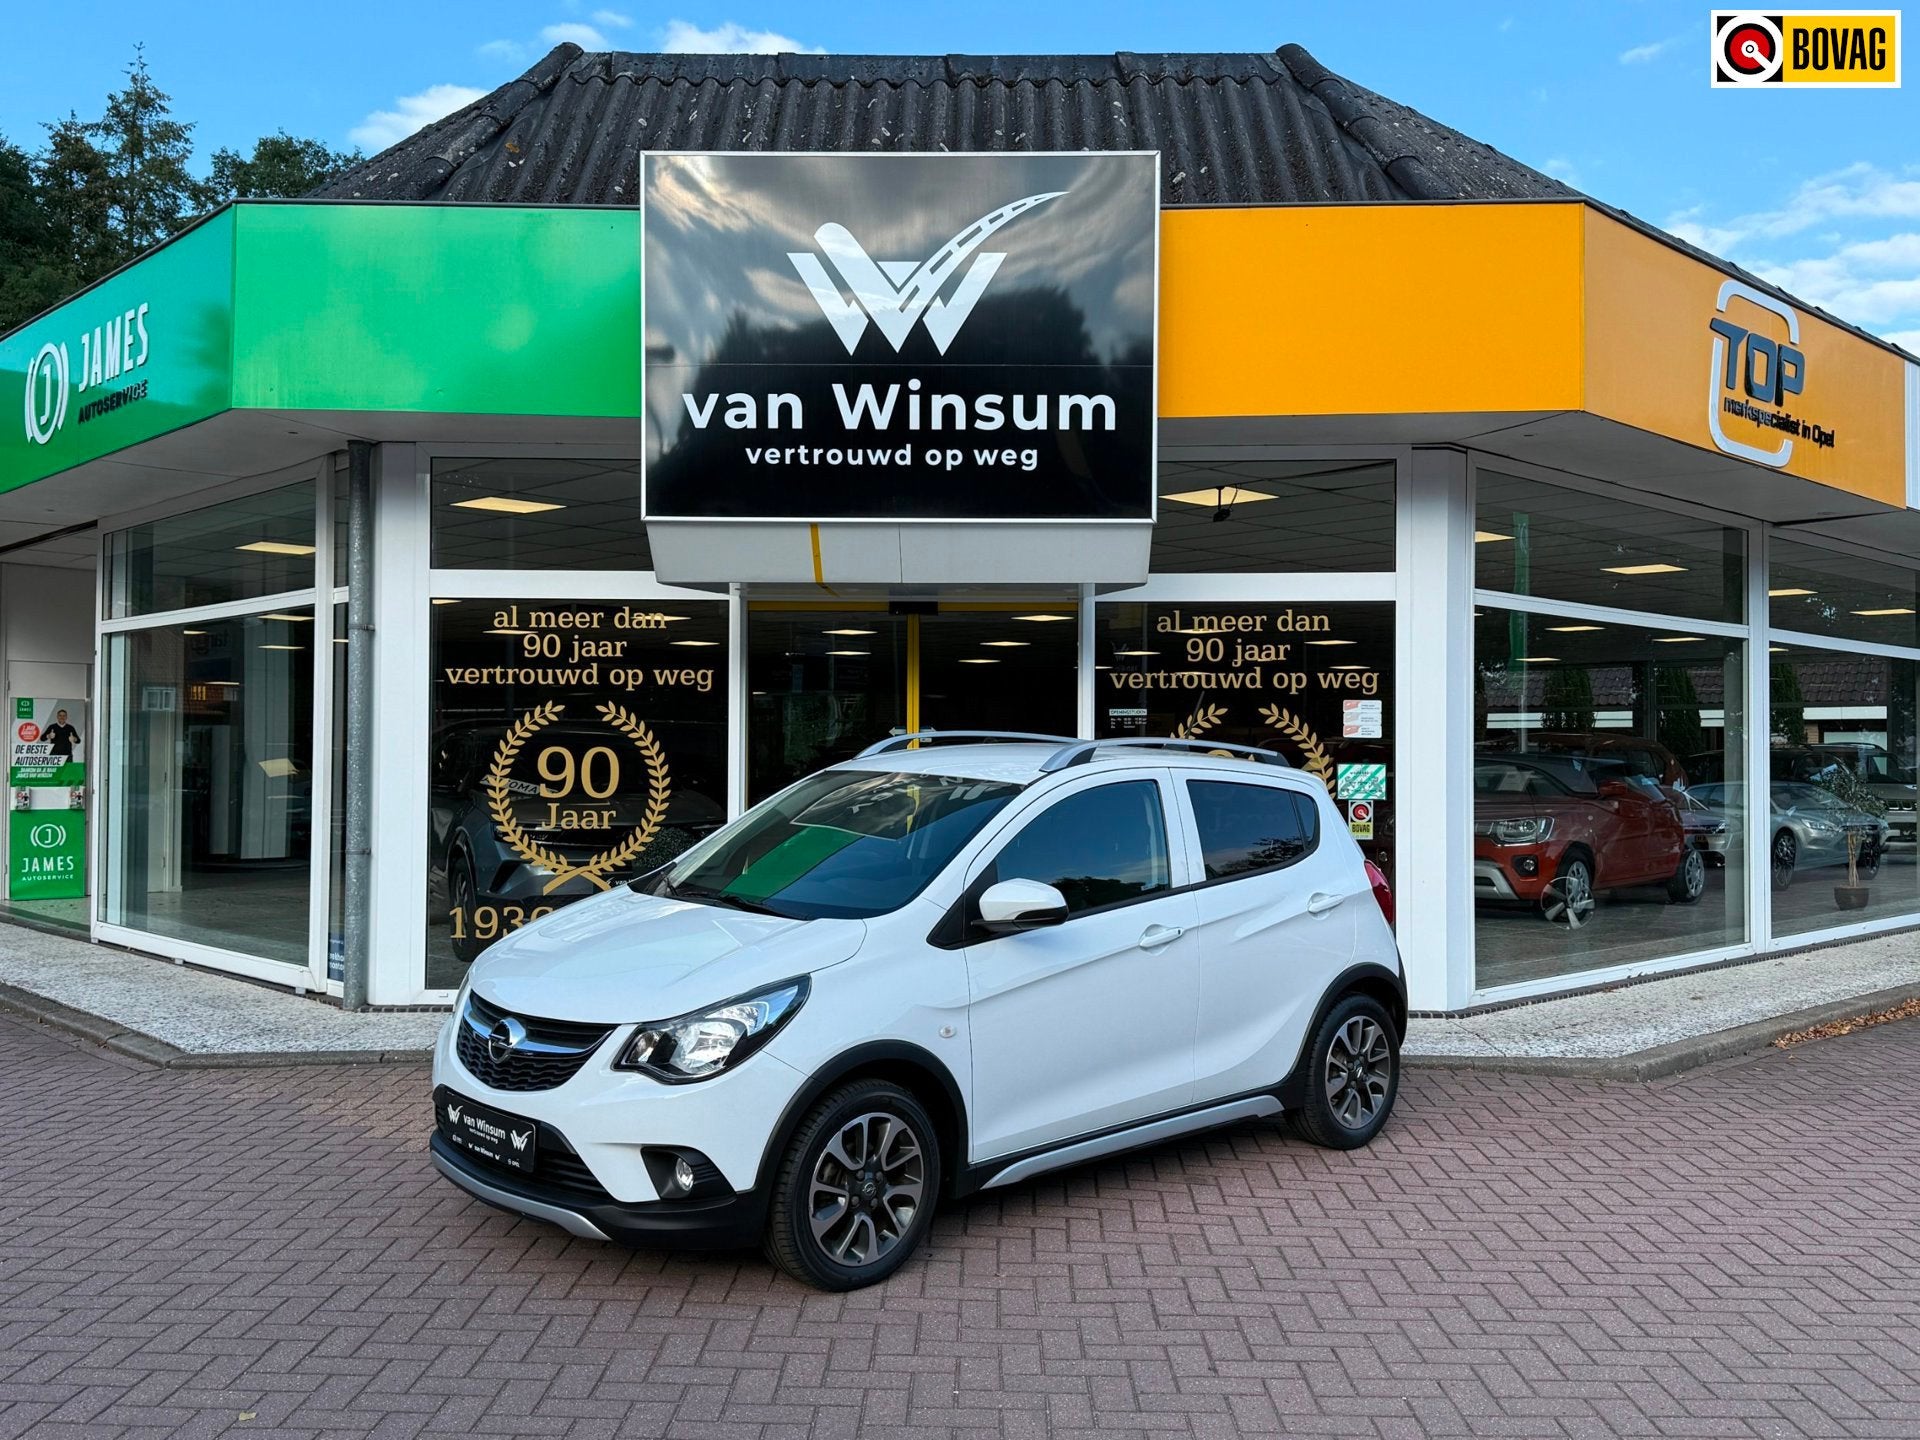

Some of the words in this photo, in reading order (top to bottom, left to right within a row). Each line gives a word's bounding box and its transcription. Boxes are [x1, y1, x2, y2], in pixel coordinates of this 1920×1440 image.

[78, 302, 149, 393] JAMES
[1710, 317, 1805, 407] TOP
[78, 379, 148, 425] AUTOSERVICE
[682, 392, 803, 430] van
[832, 378, 1117, 431] Winsum
[1723, 396, 1800, 434] merkspecialist
[1801, 420, 1811, 440] in
[1812, 423, 1835, 448] Opel
[745, 444, 912, 466] vertrouwd
[925, 449, 963, 471] op
[974, 449, 1039, 471] weg
[493, 606, 519, 629] al
[529, 608, 604, 629] meer
[614, 606, 668, 629] dan
[1156, 610, 1181, 632] al
[1193, 613, 1267, 632] meer
[1276, 609, 1331, 632] dan
[523, 634, 561, 658] 90
[569, 635, 627, 663] jaar
[1186, 638, 1225, 662] 90
[1232, 638, 1291, 668] jaar
[445, 663, 600, 685] vertrouwd
[609, 670, 644, 692] op
[654, 670, 714, 692] weg
[1110, 666, 1263, 689] vertrouwd
[1272, 672, 1308, 695] op
[1317, 671, 1380, 696] weg
[15, 745, 25, 754] DE
[26, 745, 48, 754] BESTE
[15, 757, 61, 765] AUTOSERVICE
[538, 747, 620, 799] 90
[542, 803, 616, 830] Jaar
[1352, 824, 1370, 833] BOVAG
[22, 856, 74, 873] JAMES
[463, 1114, 475, 1126] van
[476, 1118, 506, 1140] Winsum
